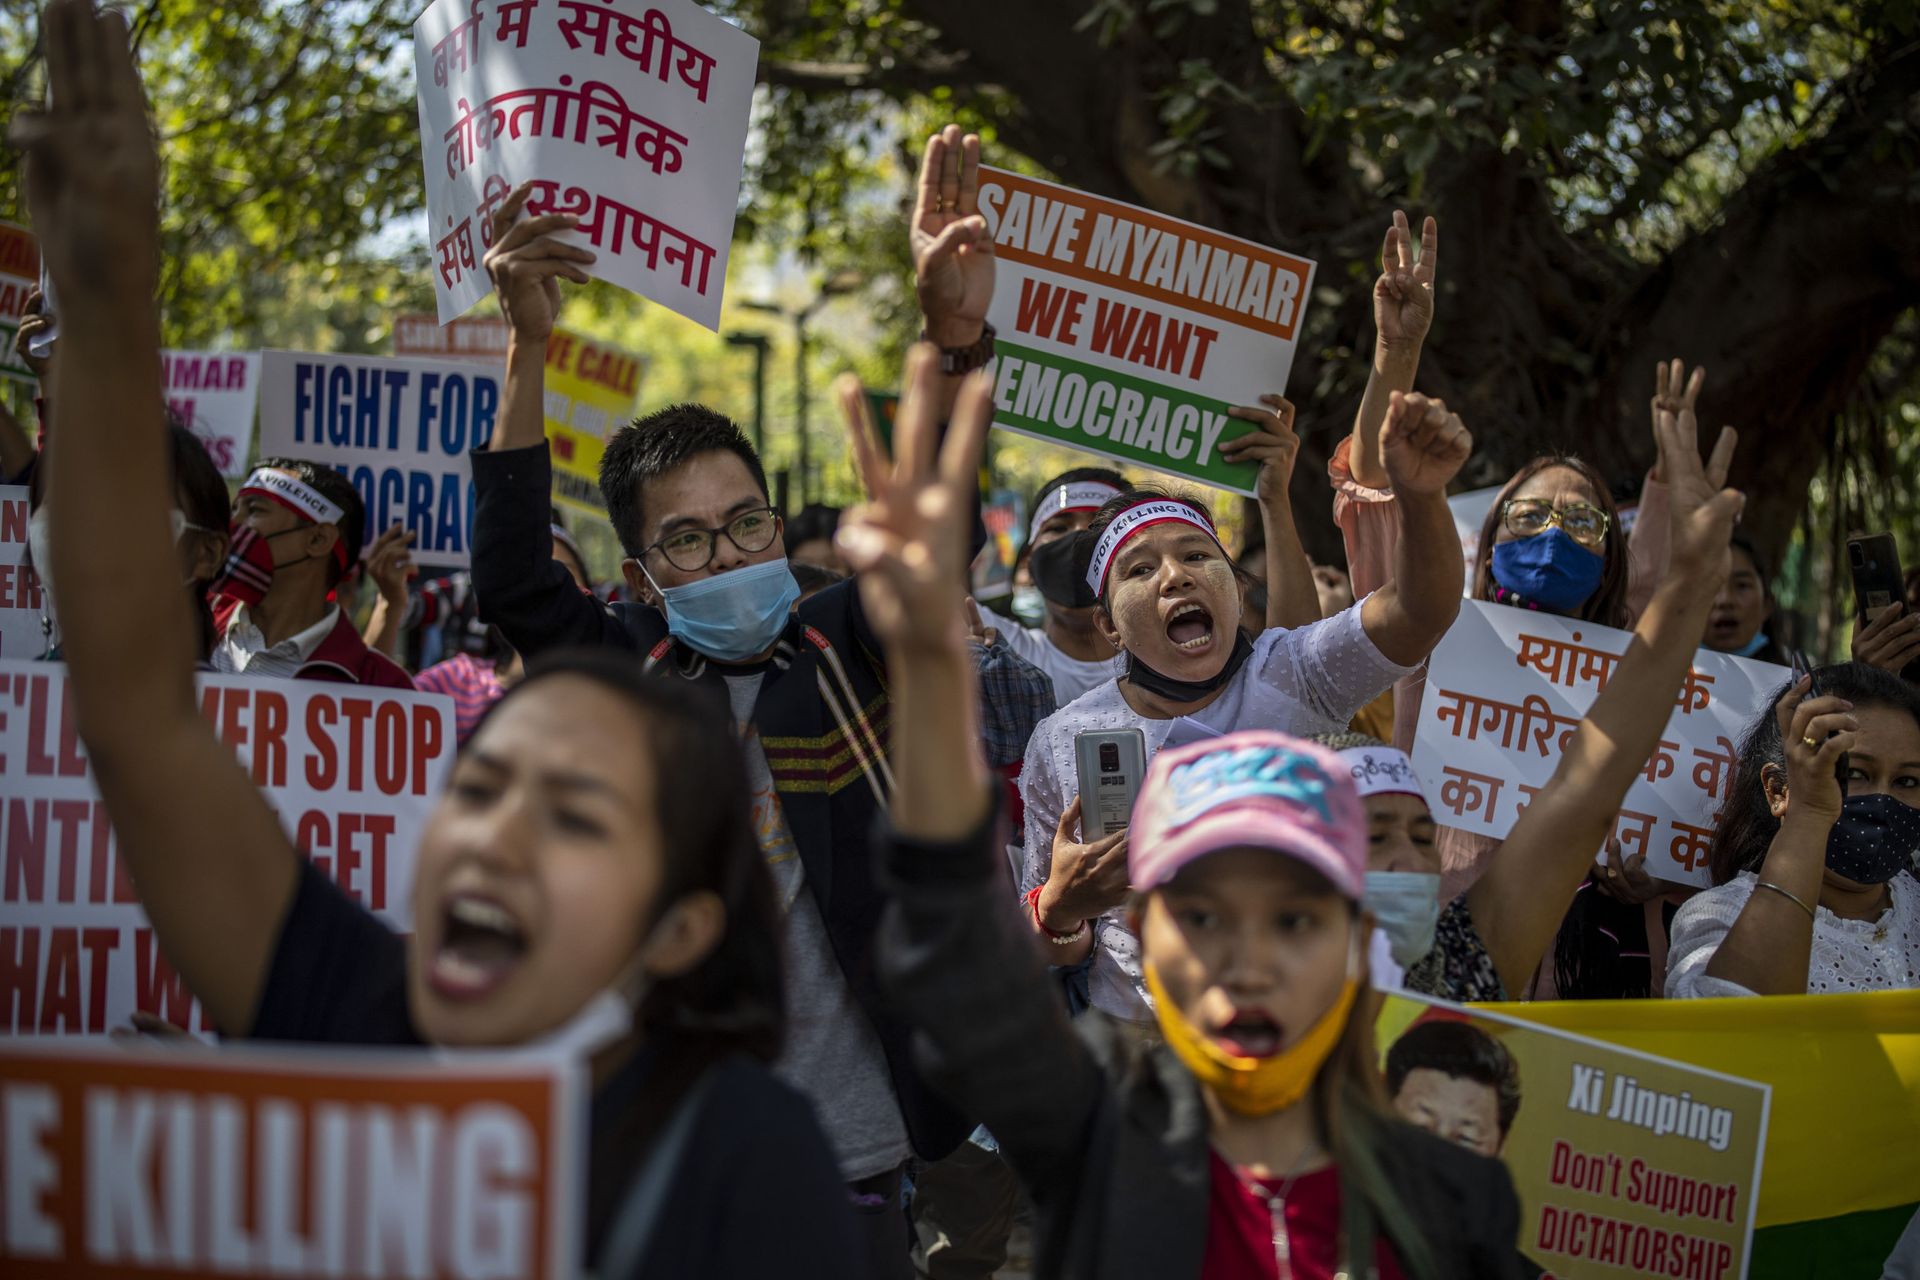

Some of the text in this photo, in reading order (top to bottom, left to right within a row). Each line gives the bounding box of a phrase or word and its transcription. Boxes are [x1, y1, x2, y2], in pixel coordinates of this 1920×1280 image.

[444, 74, 688, 181] लोकतांत्रिक
[436, 214, 477, 291] संघ
[977, 183, 1300, 328] SAVE MYANMAR
[1015, 277, 1219, 382] WE WANT
[294, 363, 410, 451] FIGHT
[417, 372, 498, 456] FOR
[994, 352, 1229, 467] EMOCRACY
[265, 474, 329, 517] VIOLENCE
[311, 464, 476, 553] OCRA
[1093, 535, 1112, 578] STOP
[1112, 504, 1178, 536] KILLING
[1181, 507, 1198, 521] IN
[304, 693, 443, 796] STOP
[1440, 765, 1505, 824] का
[1568, 1063, 1733, 1151] Xi Jinping
[88, 1088, 541, 1280] KILLING
[1549, 1140, 1738, 1224] Don't Support
[1537, 1206, 1732, 1280] DICTATORSHIP
